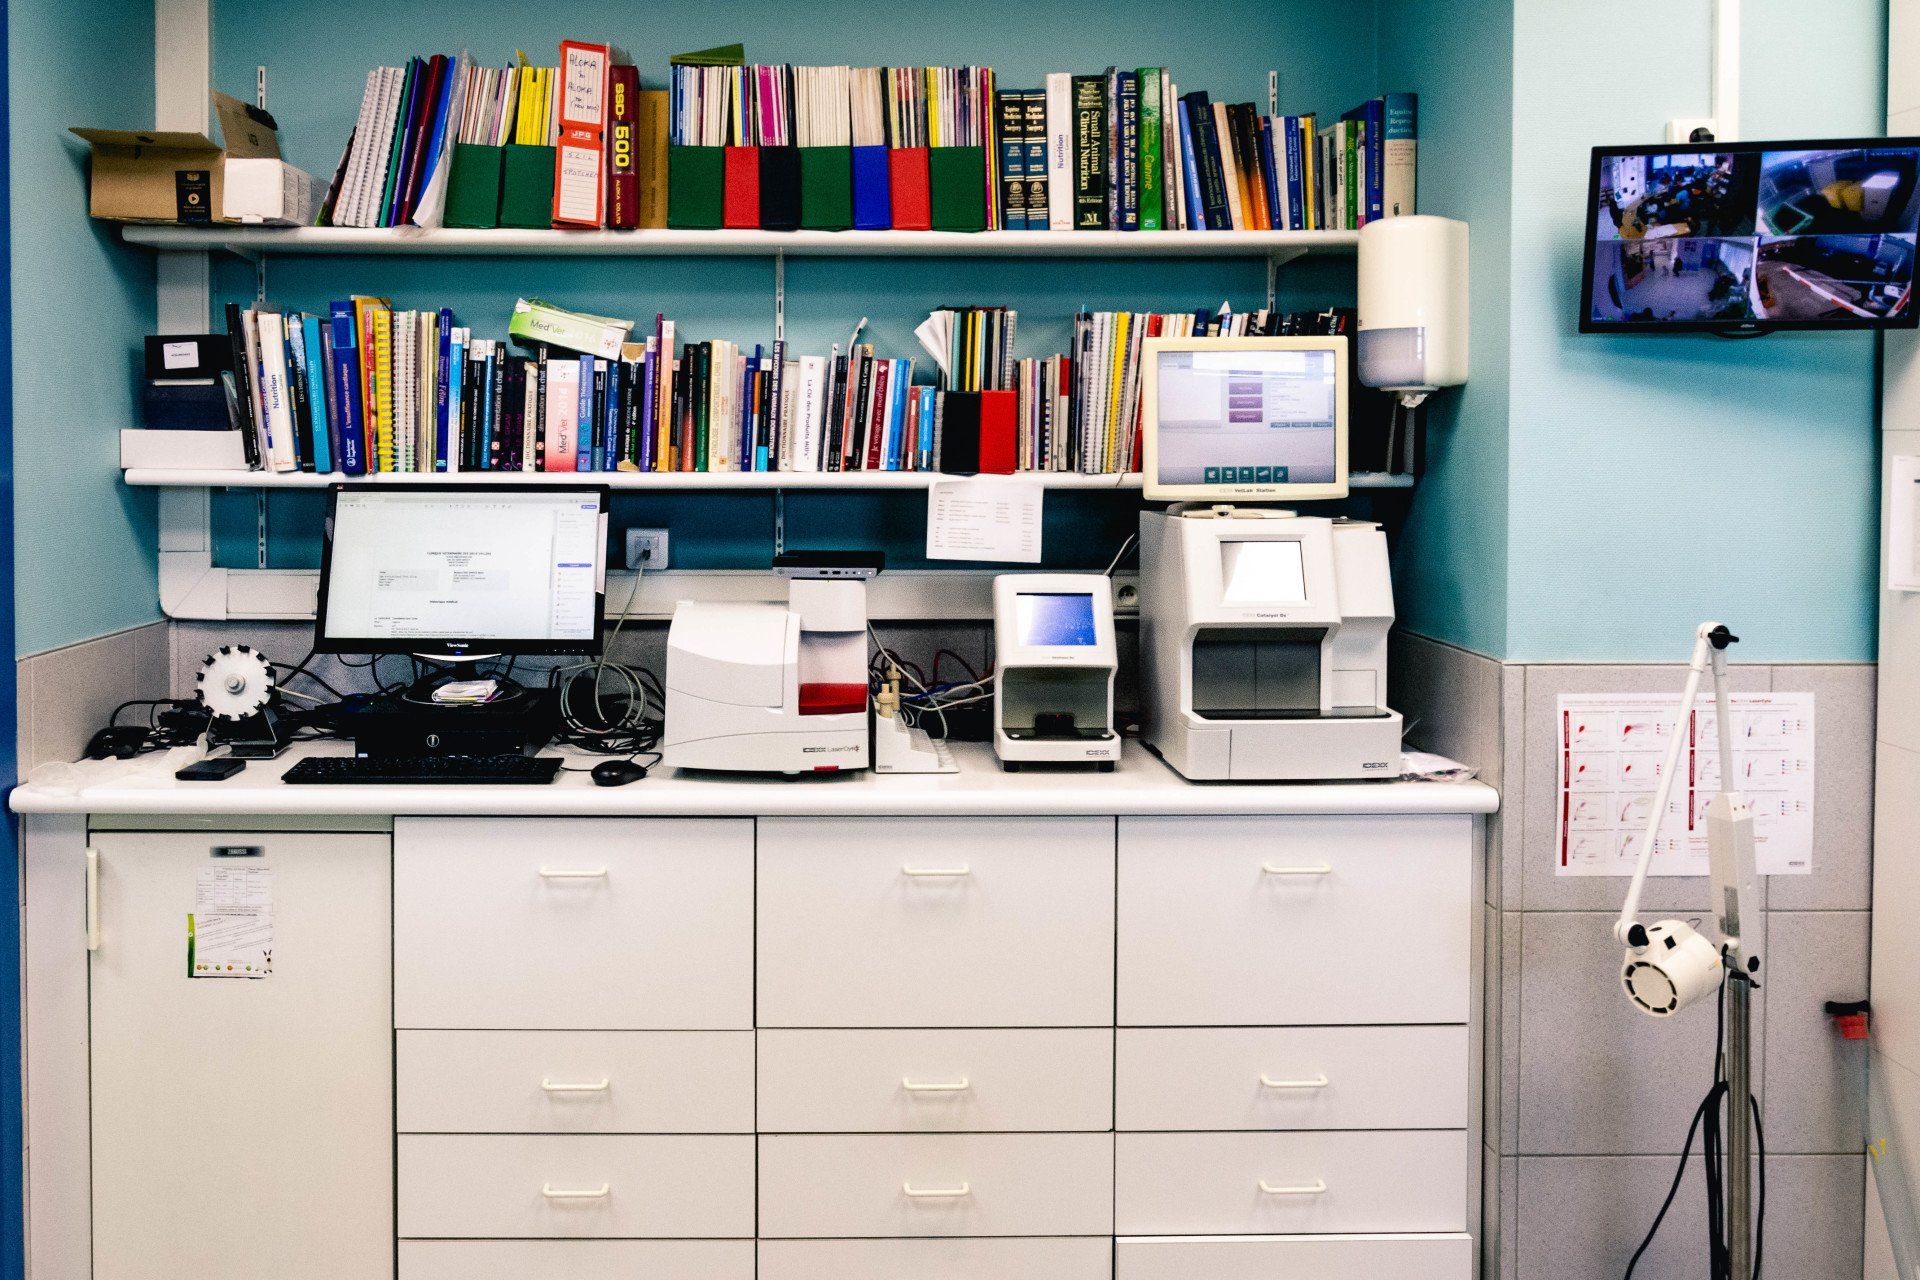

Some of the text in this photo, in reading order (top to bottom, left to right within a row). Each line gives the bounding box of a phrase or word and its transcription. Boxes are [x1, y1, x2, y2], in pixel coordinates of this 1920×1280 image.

[569, 53, 597, 70] ALOKA
[572, 130, 592, 139] JPG
[615, 83, 630, 168] SSD- 500
[1091, 110, 1101, 175] Small Animal
[1057, 133, 1065, 169] Nutrition
[1080, 110, 1091, 191] Clinical Nutrition
[271, 374, 281, 409] Nutrition
[538, 370, 546, 384] chat
[538, 384, 545, 394] du
[808, 379, 813, 387] La
[493, 370, 504, 432] alimentation du chat
[579, 398, 587, 418] Guide
[768, 342, 781, 459] LES MYCOSES DES ANIMAUX DOMESTIQUES
[781, 419, 789, 460] DICTIONNAIRE
[873, 423, 881, 444] voyage
